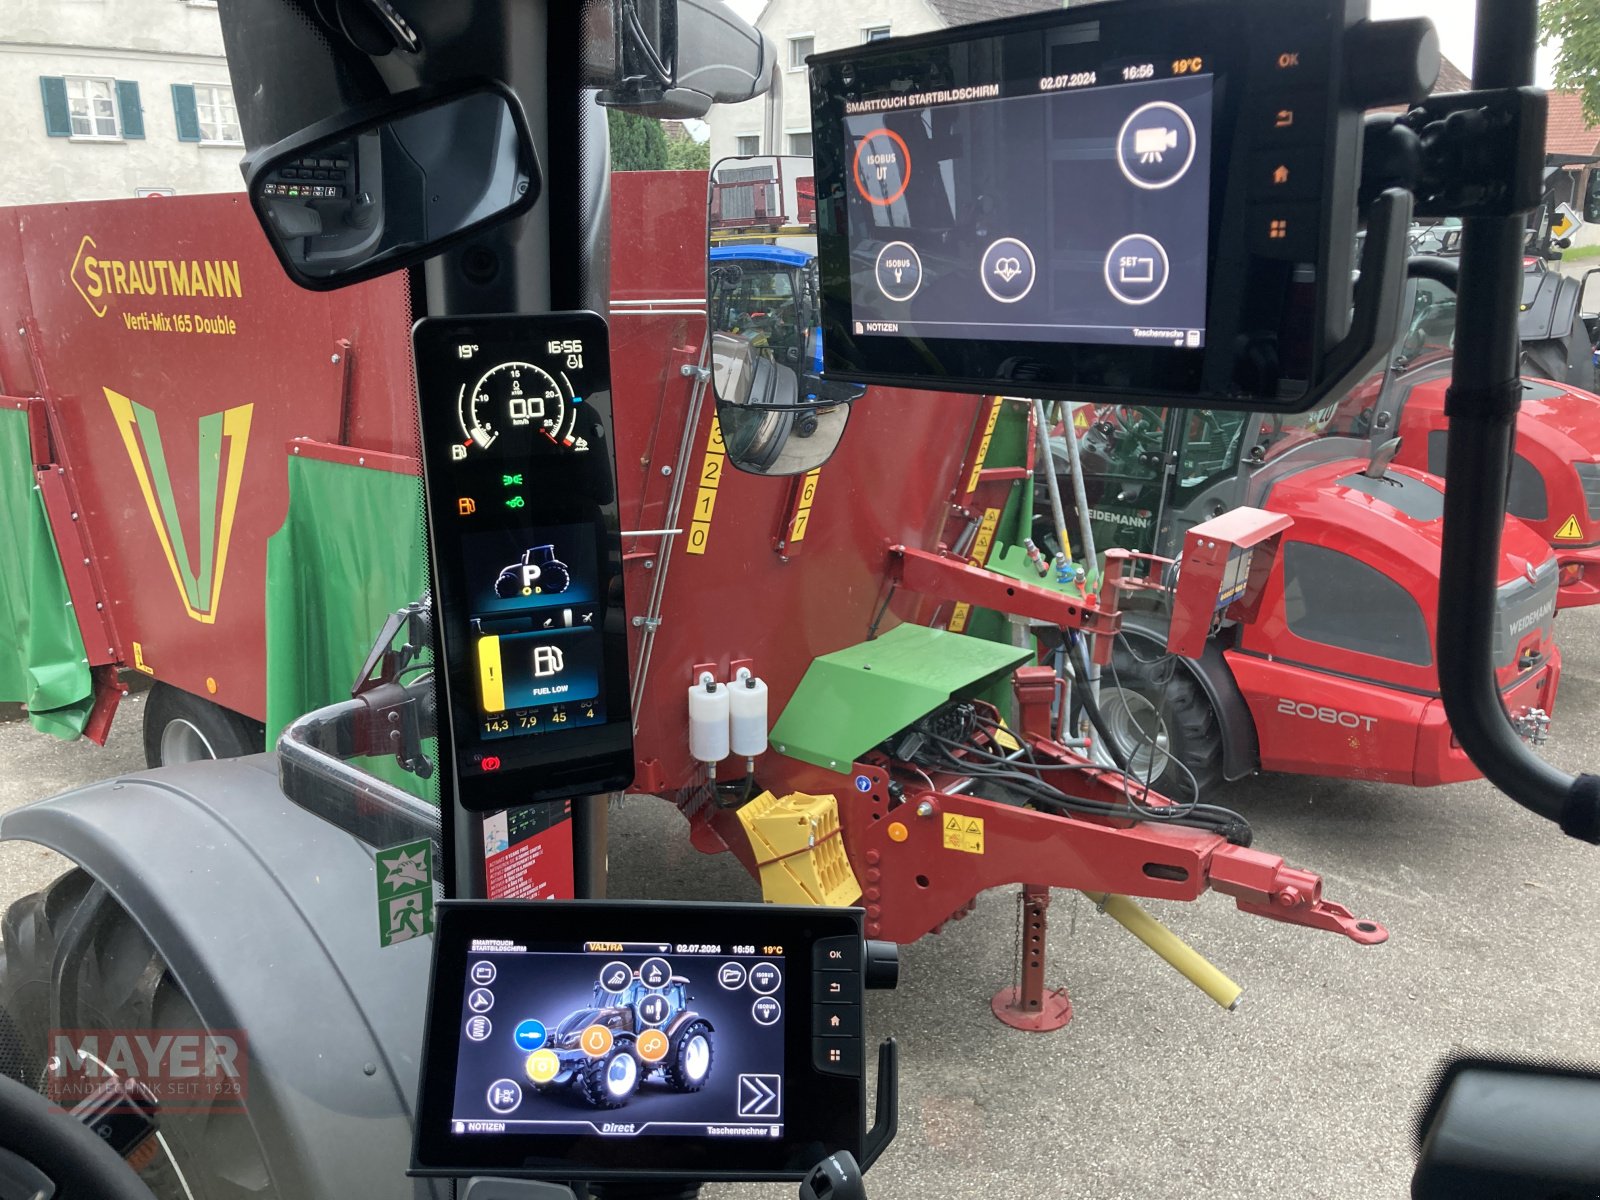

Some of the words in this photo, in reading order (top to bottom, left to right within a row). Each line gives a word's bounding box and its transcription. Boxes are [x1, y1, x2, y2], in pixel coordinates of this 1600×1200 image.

[1279, 53, 1299, 68] OK
[1040, 71, 1096, 90] 02.07.2024
[1123, 63, 1154, 80] 16:56
[1171, 57, 1203, 74] 19°C
[846, 96, 907, 114] SMARTTOUCH
[908, 84, 999, 106] STARTBILDSCHIRM
[867, 153, 896, 165] ISOBUS
[876, 167, 887, 180] UT
[886, 259, 911, 268] ISOBUS
[1120, 256, 1138, 267] SET
[84, 256, 242, 298] STRAUTMANN
[123, 312, 172, 332] Verti-Mix
[172, 313, 192, 333] 165
[195, 315, 236, 335] Double
[866, 323, 899, 332] NOTIZEN
[1133, 328, 1184, 338] Taschenrechn
[548, 340, 582, 354] 16:56
[511, 370, 520, 378] 15
[713, 426, 724, 444] 3
[705, 462, 718, 479] 2
[804, 483, 814, 500] 6
[702, 497, 711, 513] 1
[795, 516, 806, 534] 7
[692, 529, 705, 546] 0
[523, 564, 541, 586] P
[1509, 599, 1552, 636] WEIDEMANN
[533, 687, 551, 696] FUEL
[552, 685, 569, 694] LOW
[485, 720, 509, 732] 14,3
[520, 716, 537, 728] 7,9
[552, 712, 567, 723] 45
[586, 708, 594, 718] 4
[1277, 698, 1378, 732] 2080T
[589, 943, 623, 952] VALTRA
[677, 944, 721, 954] 02.07.2024
[732, 945, 755, 954] 16:56
[763, 946, 783, 955] 19°C
[829, 950, 842, 959] OK
[646, 1005, 654, 1014] M
[469, 1123, 505, 1132] NOTIZEN
[602, 1122, 635, 1133] Direct
[707, 1127, 767, 1136] Taschenrechner
